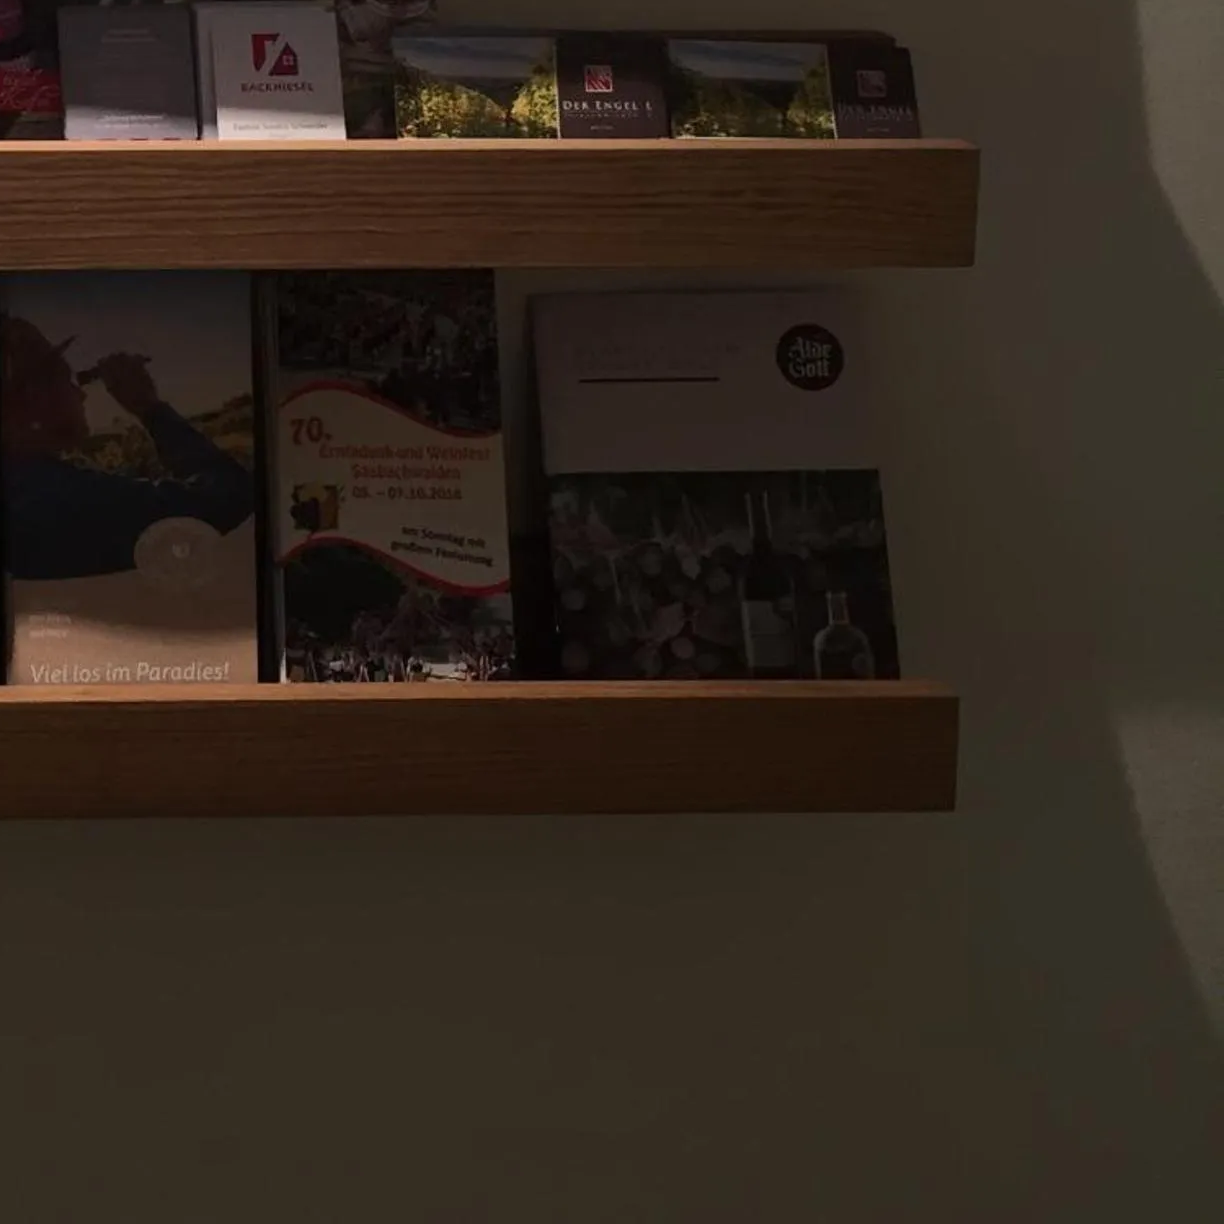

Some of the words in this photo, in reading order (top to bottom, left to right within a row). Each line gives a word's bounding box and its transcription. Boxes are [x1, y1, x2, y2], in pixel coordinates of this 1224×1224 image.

[561, 99, 590, 111] DER
[290, 415, 333, 446] 70.
[350, 464, 462, 480] Sasbachwalden
[420, 528, 466, 547] Sonntag
[29, 663, 70, 684] Viel
[72, 663, 101, 684] los
[105, 663, 132, 681] im
[136, 661, 230, 682] Paradies!
